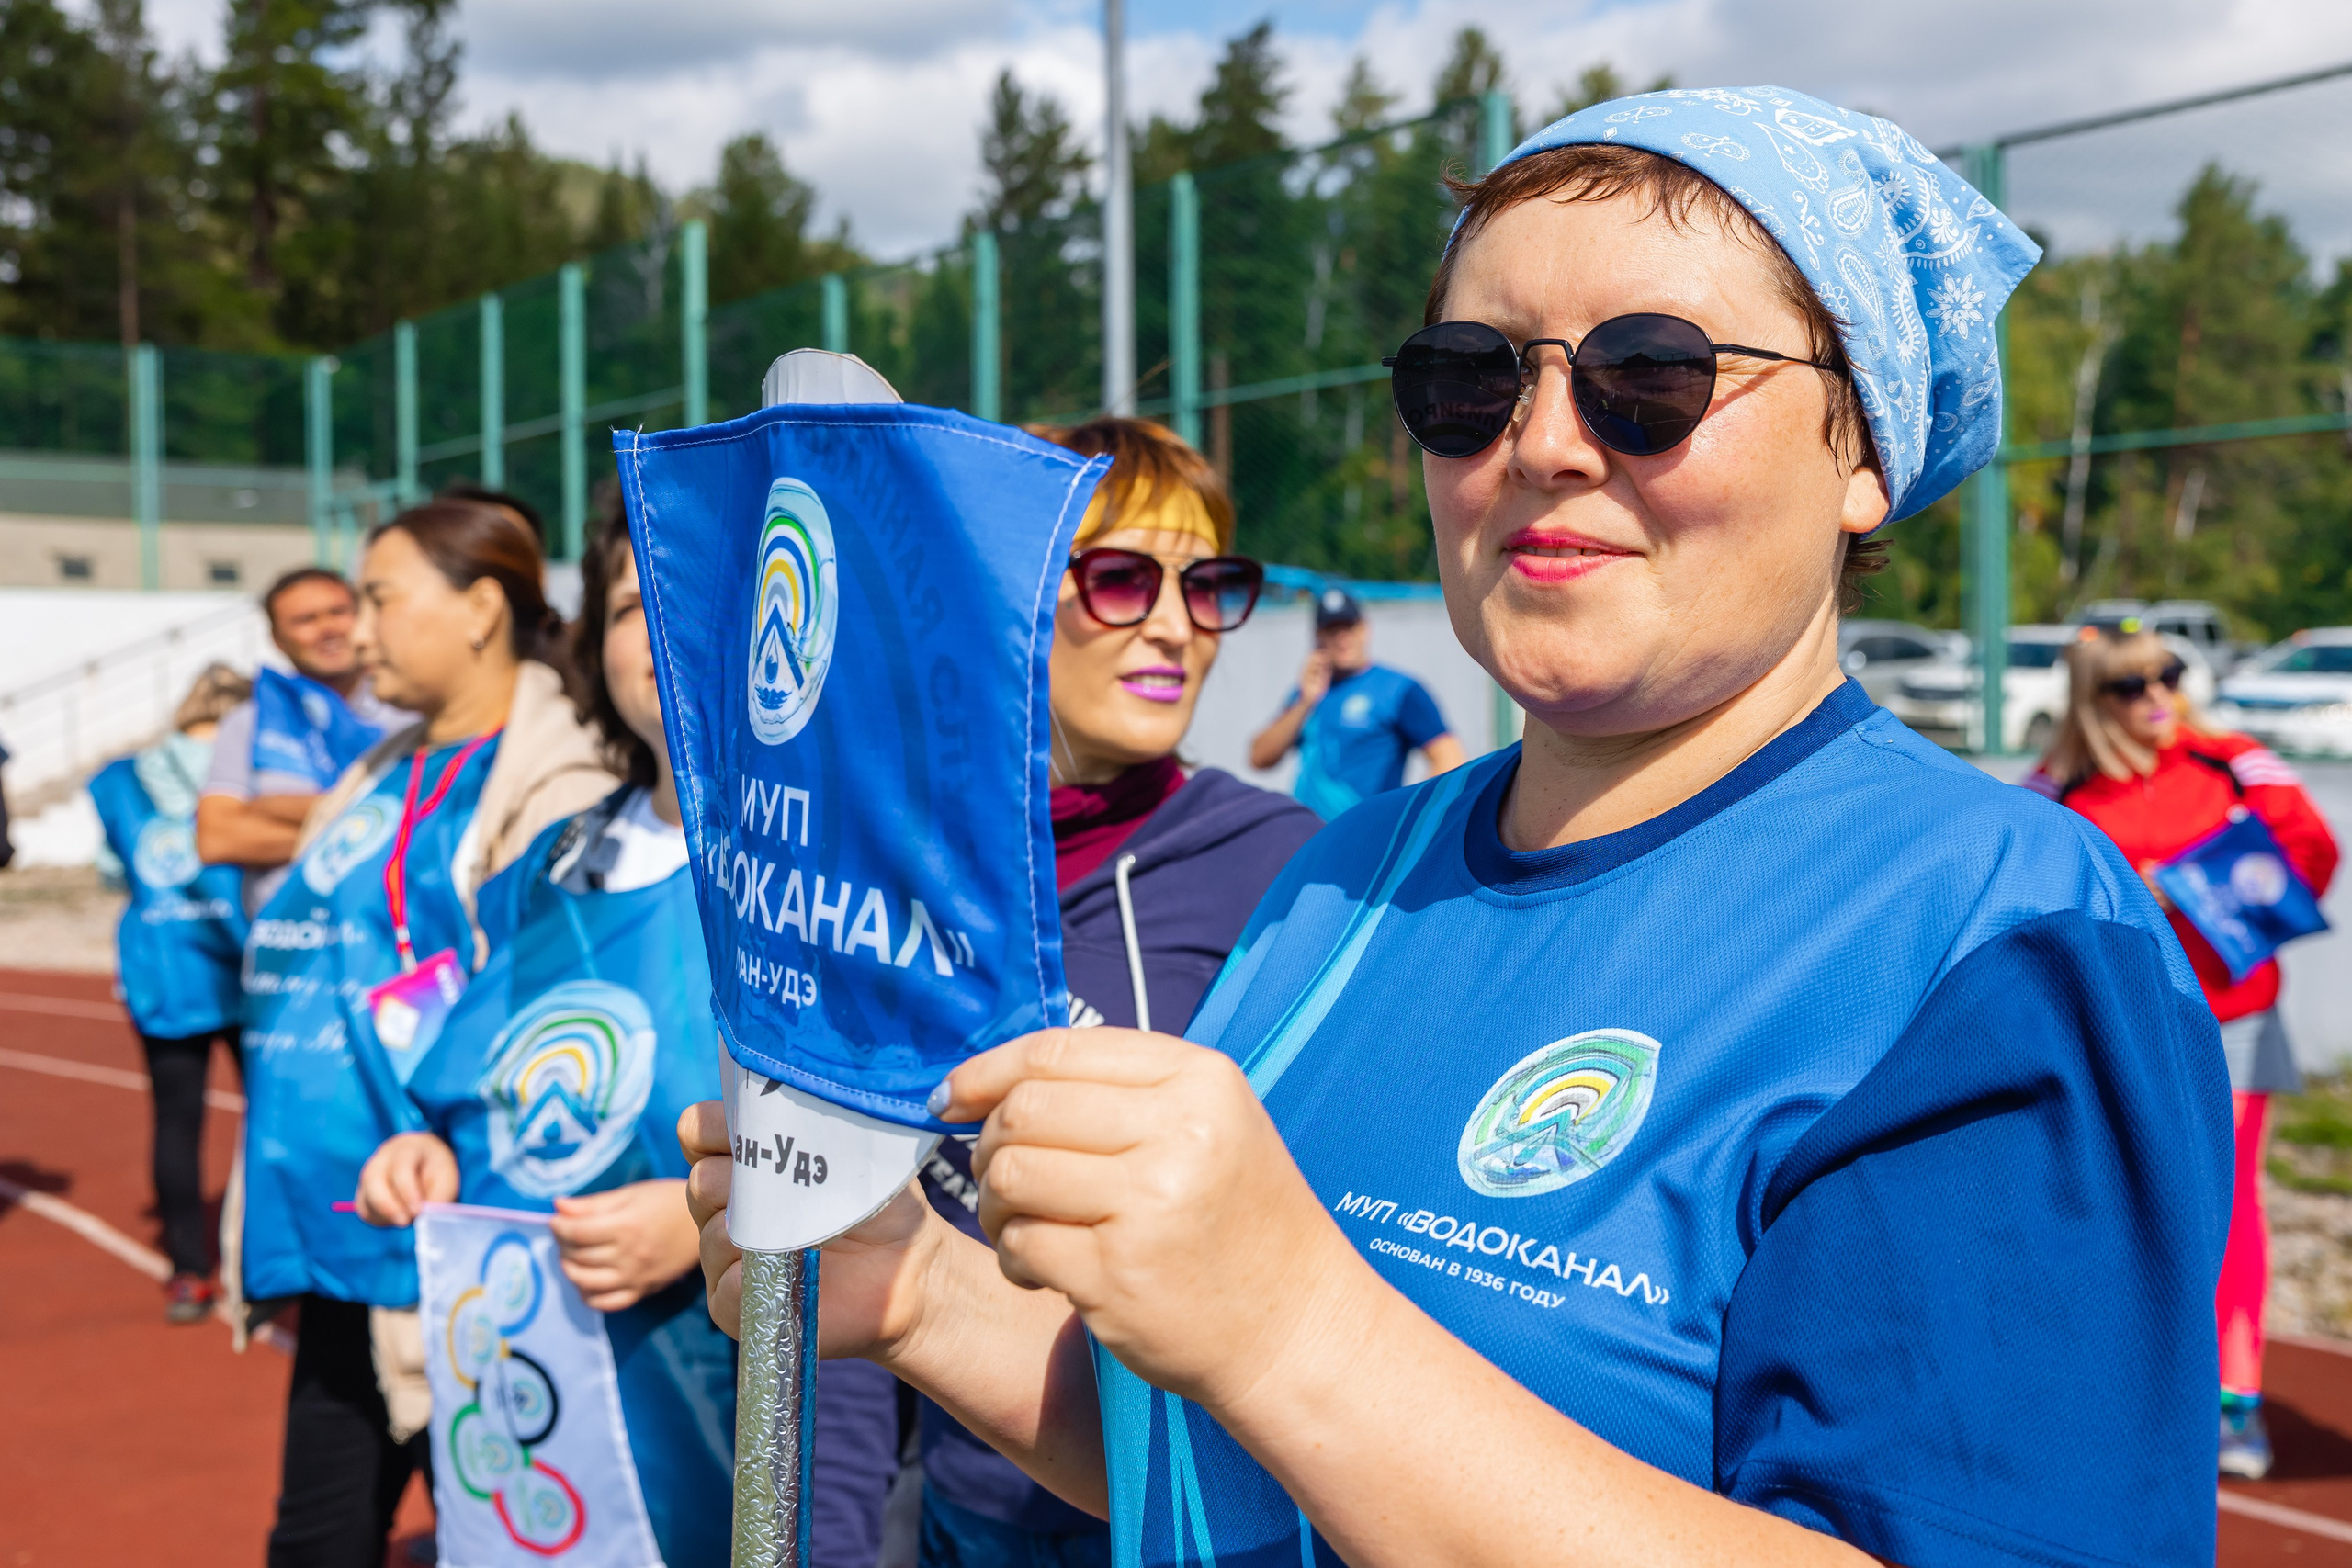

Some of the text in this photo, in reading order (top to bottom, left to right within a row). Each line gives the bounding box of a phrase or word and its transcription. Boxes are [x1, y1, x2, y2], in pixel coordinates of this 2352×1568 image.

[741, 773, 810, 847] МУП
[1335, 1190, 1670, 1306] МУП «ВОДОКАНАЛ»
[1369, 1237, 1566, 1310] ОСНОВАН В 1936 ГОДУ
